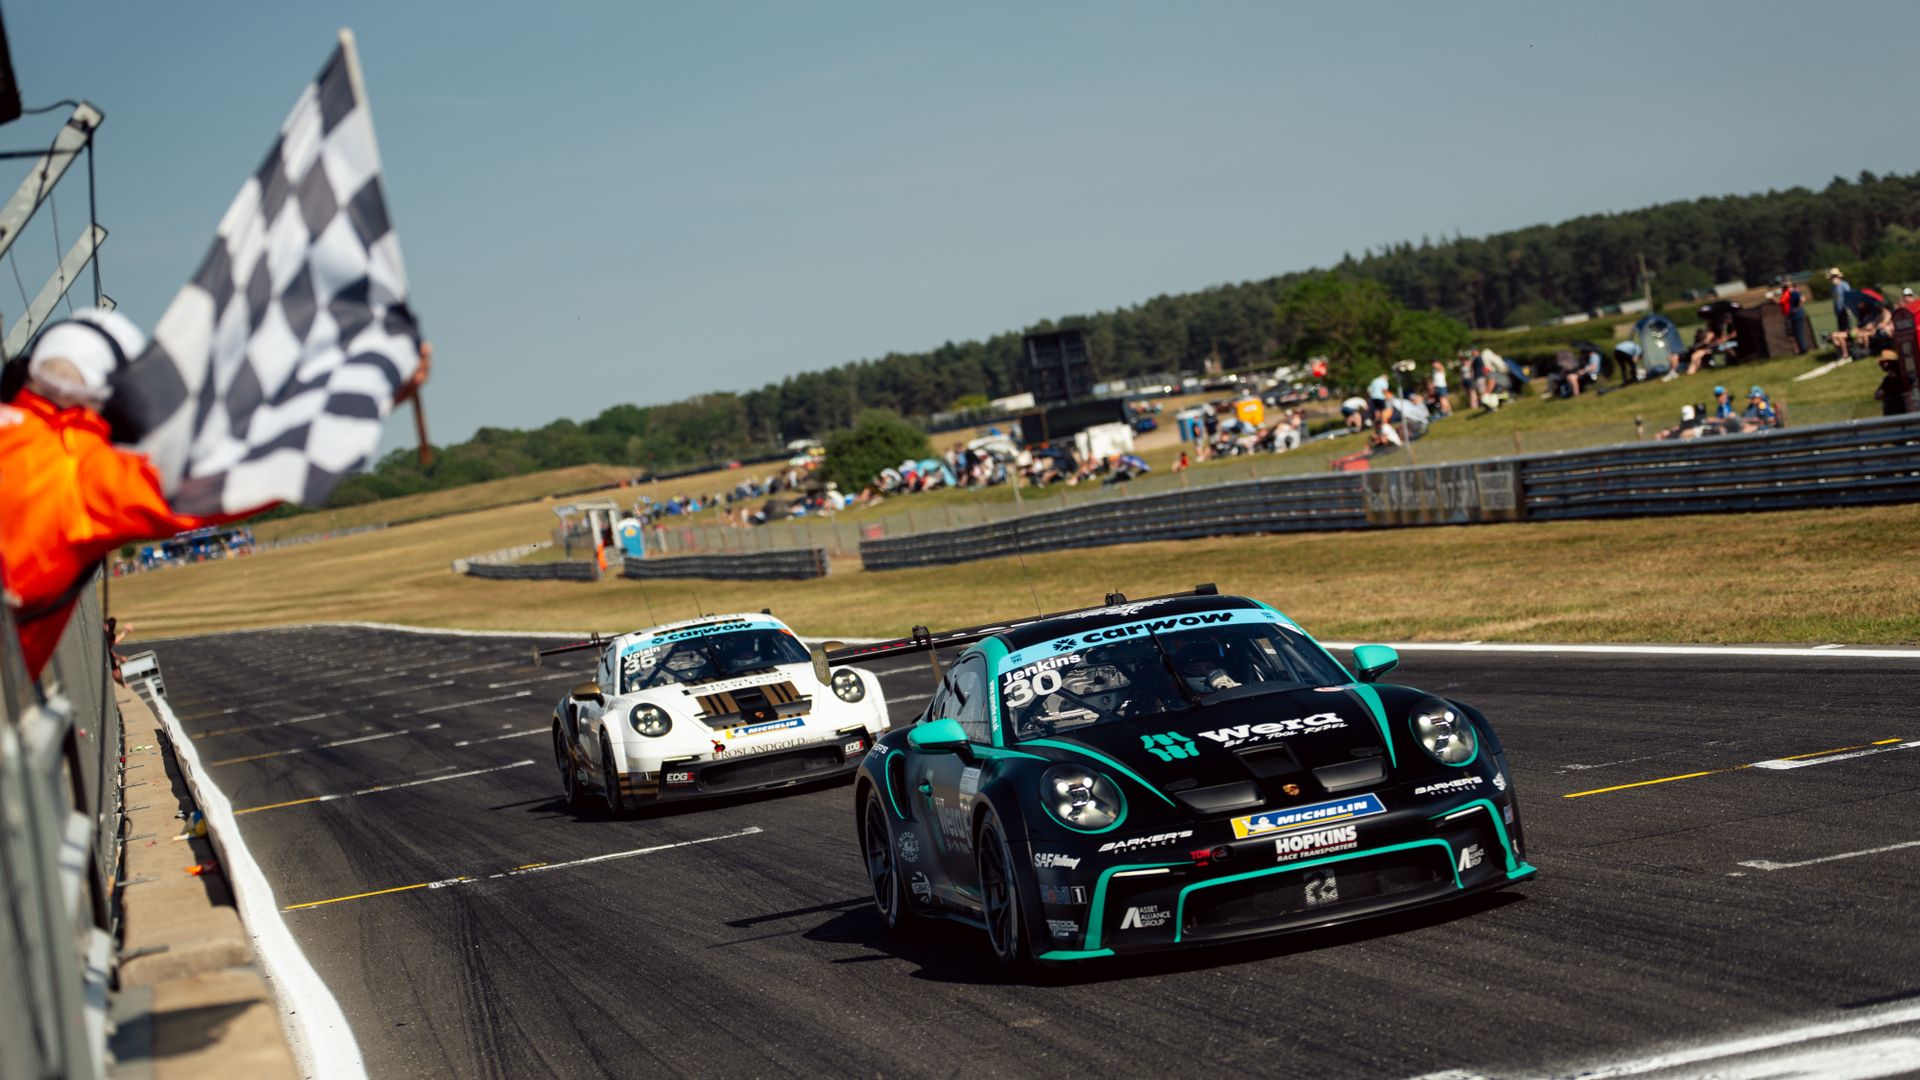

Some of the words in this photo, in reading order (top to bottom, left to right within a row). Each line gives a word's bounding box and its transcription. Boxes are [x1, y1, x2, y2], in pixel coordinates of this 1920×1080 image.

[668, 623, 752, 640] carwow
[1082, 612, 1233, 643] carwow
[624, 654, 657, 675] 35
[1003, 654, 1082, 686] Jenkins
[1003, 669, 1062, 708] 30
[749, 719, 799, 734] MICHELIN
[1198, 712, 1344, 743] Wera
[1223, 738, 1245, 748] BE
[1265, 730, 1298, 740] TOOL
[1303, 722, 1348, 735] REBEL
[845, 739, 865, 753] EDGE
[666, 771, 696, 781] EDGE
[1277, 800, 1368, 825] MICHELIN
[1098, 830, 1193, 852] BARKER'S
[1114, 839, 1177, 854] FINANCE
[1275, 825, 1358, 854] HOPKINS
[1190, 848, 1211, 860] TOW
[1276, 853, 1299, 862] RACE
[1300, 841, 1358, 858] TRANSPORTERS
[1140, 905, 1158, 913] ASSET
[1140, 910, 1171, 920] ALLIANCE
[1141, 918, 1165, 927] GROUP
